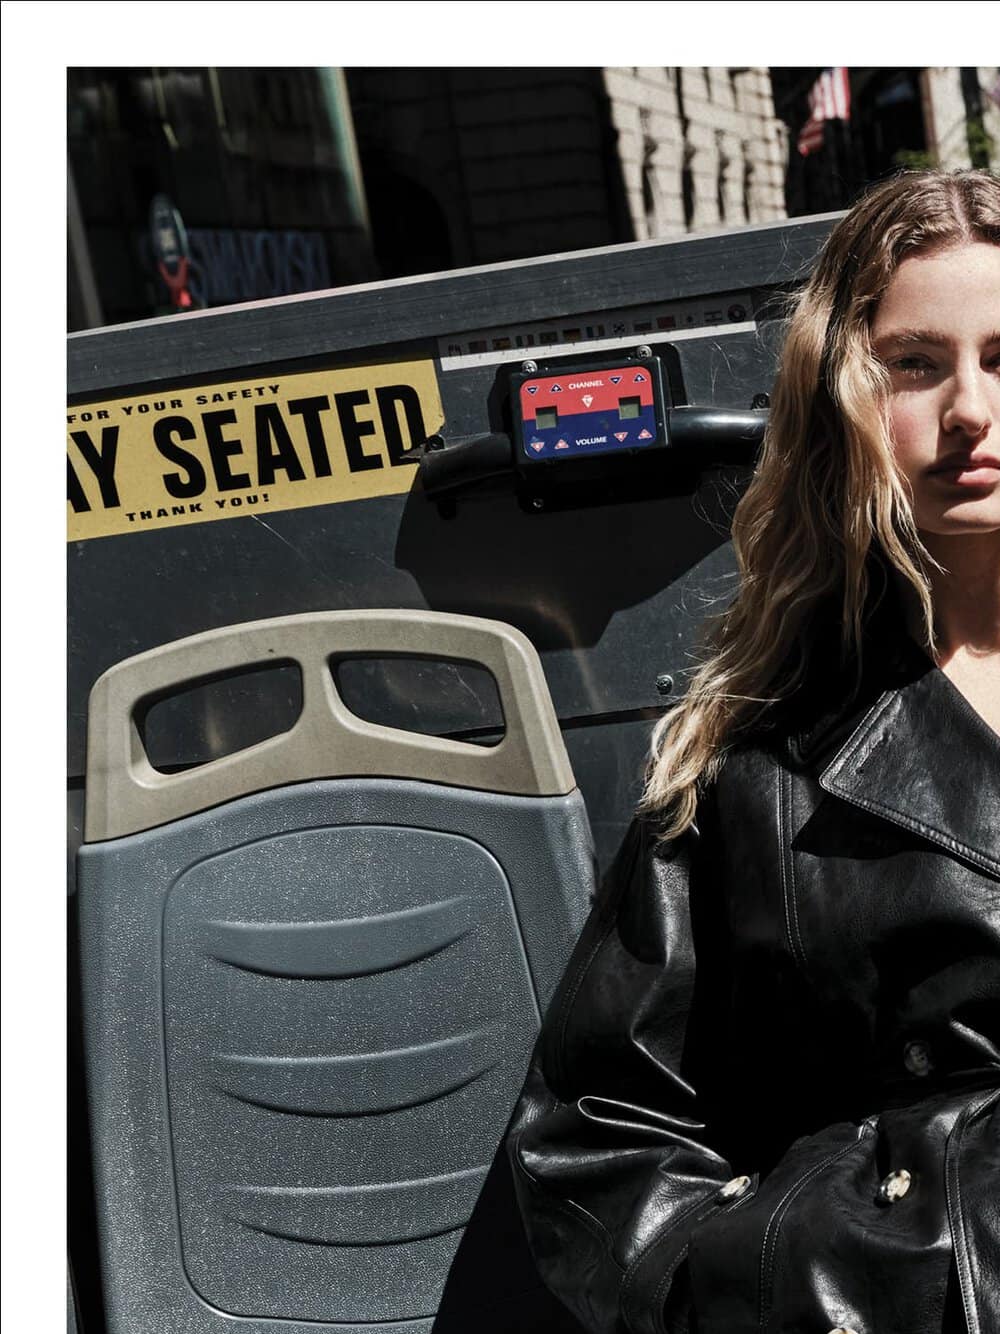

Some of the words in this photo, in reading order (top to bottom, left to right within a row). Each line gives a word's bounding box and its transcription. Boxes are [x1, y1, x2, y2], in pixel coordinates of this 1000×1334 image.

[568, 379, 604, 390] CHANNEL
[67, 409, 109, 424] FOR
[121, 399, 183, 416] YOUR
[195, 384, 280, 405] SAFETY
[153, 384, 427, 498] SEATED
[575, 436, 607, 446] VOLUME
[126, 502, 203, 522] THANK
[214, 493, 270, 509] YOU!
